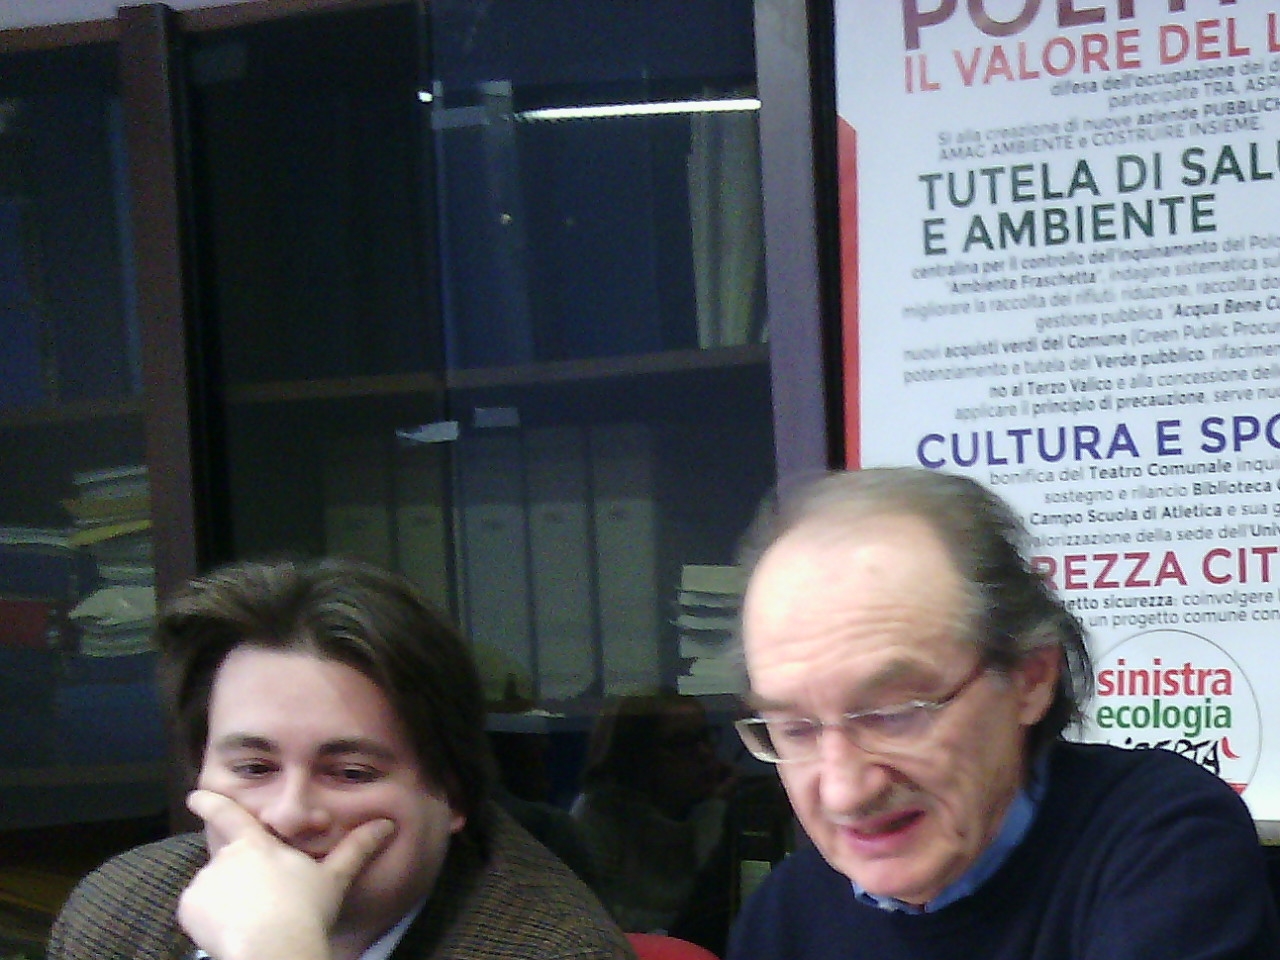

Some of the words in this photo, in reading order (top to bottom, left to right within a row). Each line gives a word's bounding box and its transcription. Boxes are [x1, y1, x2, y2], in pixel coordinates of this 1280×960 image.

[904, 54, 942, 93] IL
[953, 29, 1142, 87] VALORE
[1159, 17, 1250, 64] DEL
[1050, 79, 1098, 96] difesa
[1102, 66, 1234, 90] dell'occupazione
[1240, 60, 1264, 77] dei
[1108, 86, 1198, 110] partecipate
[940, 143, 984, 160] AMAC
[990, 134, 1074, 156] AMBIENTE
[1078, 136, 1088, 147] e
[1092, 124, 1184, 146] COSTRUIRE
[956, 128, 982, 144] alla
[986, 122, 1060, 141] creazione
[1064, 118, 1078, 133] di
[1082, 116, 1132, 131] nuove
[1136, 107, 1198, 126] aziende
[919, 159, 1100, 210] TUTELA
[1116, 152, 1161, 194] DI
[923, 217, 947, 255] E
[962, 193, 1217, 252] AMBIENTE
[912, 260, 978, 279] centralina
[982, 260, 1004, 277] per
[1020, 251, 1084, 270] controllo
[1222, 236, 1246, 253] del
[1110, 262, 1170, 282] indagine
[1174, 255, 1258, 275] sistematica
[974, 297, 986, 312] la
[990, 293, 1046, 311] raccolta
[1050, 290, 1072, 306] dei
[1196, 276, 1256, 295] raccolta
[1036, 311, 1098, 332] gestione
[1100, 305, 1162, 327] pubblica
[1224, 298, 1262, 313] Bene
[944, 339, 998, 360] acquisti
[1002, 336, 1036, 353] verdi
[1042, 334, 1062, 350] del
[1066, 333, 1126, 348] Comune
[1184, 323, 1228, 340] Public
[904, 360, 1008, 386] potenziamento
[1012, 363, 1020, 374] e
[1024, 356, 1064, 373] tutela
[1070, 354, 1092, 370] del
[1094, 351, 1138, 368] Verde
[988, 386, 1008, 398] no
[1012, 381, 1022, 396] al
[1028, 380, 1066, 395] Terzo
[1070, 376, 1112, 392] Valico
[1116, 378, 1126, 389] e
[1130, 373, 1152, 388] alla
[1156, 367, 1248, 386] concessione
[956, 401, 1018, 421] applicare
[1032, 395, 1096, 417] principio
[1100, 393, 1112, 408] di
[1214, 388, 1252, 401] serve
[917, 423, 1140, 468] CULTURA
[1156, 420, 1183, 456] E
[990, 468, 1054, 484] bonifica
[1058, 465, 1084, 481] del
[1090, 463, 1142, 479] Teatro
[1146, 458, 1232, 477] Comunale
[1044, 487, 1112, 505] sostegno
[1118, 488, 1128, 499] e
[1132, 482, 1186, 499] rilancio
[1192, 479, 1272, 496] Biblioteca
[1030, 511, 1082, 528] Campo
[1088, 506, 1138, 523] Scuola
[1142, 505, 1156, 520] di
[1160, 503, 1222, 519] Atletica
[1226, 505, 1236, 516] e
[1240, 504, 1266, 516] sua
[1136, 528, 1172, 543] della
[1176, 526, 1214, 541] sede
[1182, 589, 1272, 608] coinvolgere
[1090, 615, 1108, 626] un
[1112, 609, 1178, 629] progetto
[1184, 610, 1246, 623] comune
[1252, 609, 1280, 621] con
[1097, 658, 1232, 697] sinistra
[1096, 698, 1232, 737] ecologia
